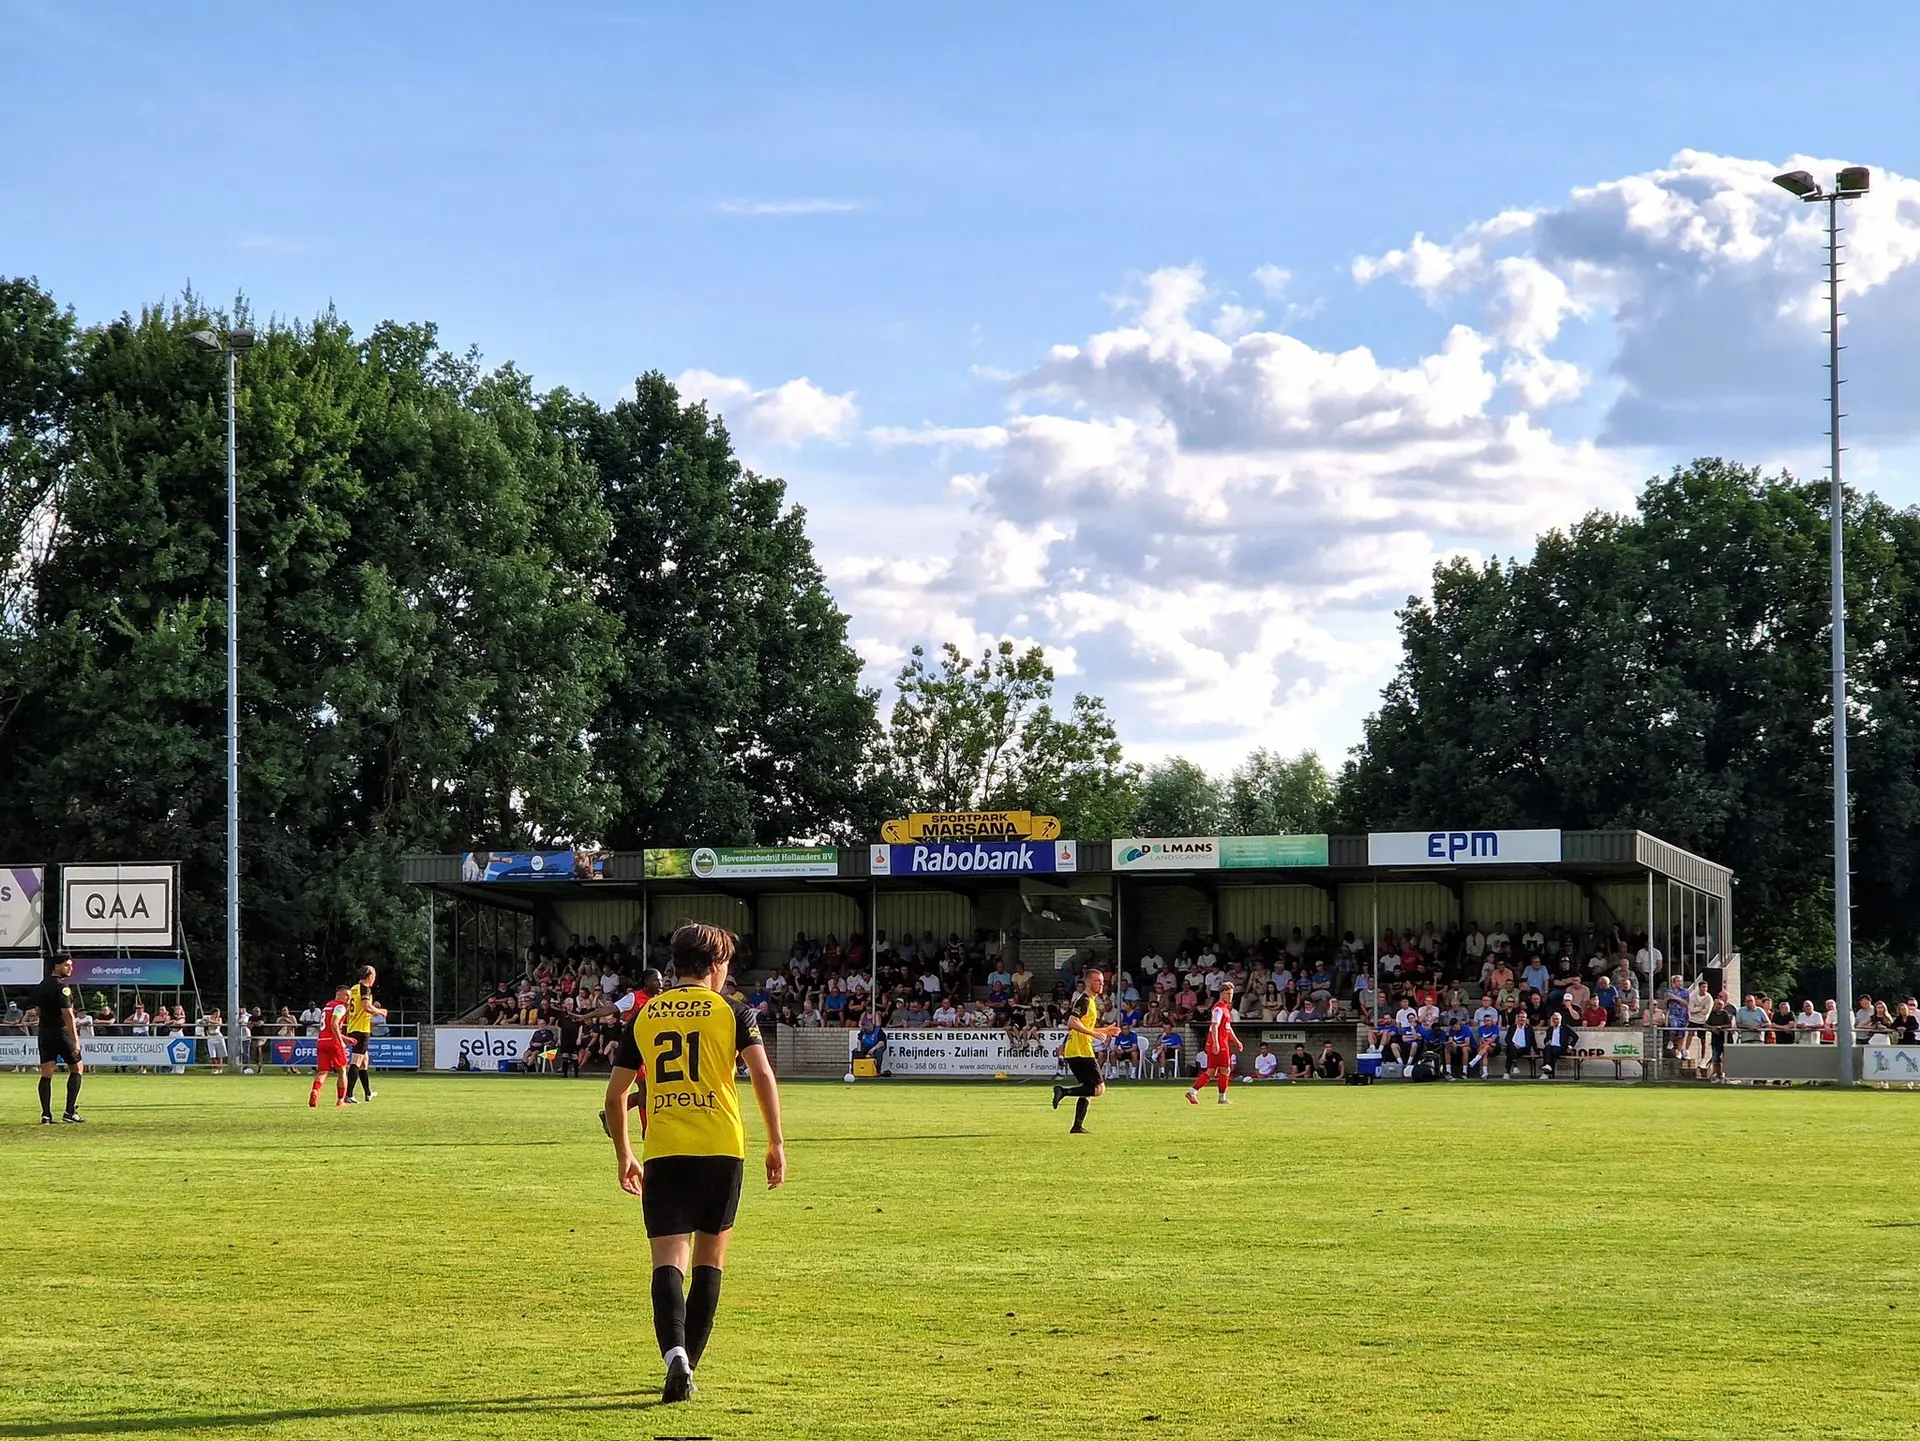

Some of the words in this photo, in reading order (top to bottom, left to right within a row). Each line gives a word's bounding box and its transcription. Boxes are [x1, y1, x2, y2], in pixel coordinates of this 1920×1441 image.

[931, 813, 1009, 823] SPORTPARK
[922, 822, 1018, 837] MARSANA
[1428, 832, 1498, 862] EPM
[721, 853, 780, 862] Hoveniersbedrijf
[781, 853, 821, 861] Hollanders
[912, 843, 1034, 872] Rabobank
[85, 892, 150, 919] QAA
[92, 966, 141, 975] elk-events.nl
[648, 1000, 712, 1013] KNOPS
[648, 1010, 711, 1020] VASTGOED
[885, 1032, 943, 1040] EERSSEN
[947, 1032, 1006, 1041] BEDANKT
[84, 1043, 113, 1053] WALSTOCK
[117, 1043, 164, 1053] FIETSSPECIALIST
[460, 1031, 517, 1056] selas
[654, 1031, 700, 1084] 21
[888, 1047, 896, 1058] F.
[899, 1046, 945, 1060] Reijnders
[954, 1046, 988, 1058] Zuliani
